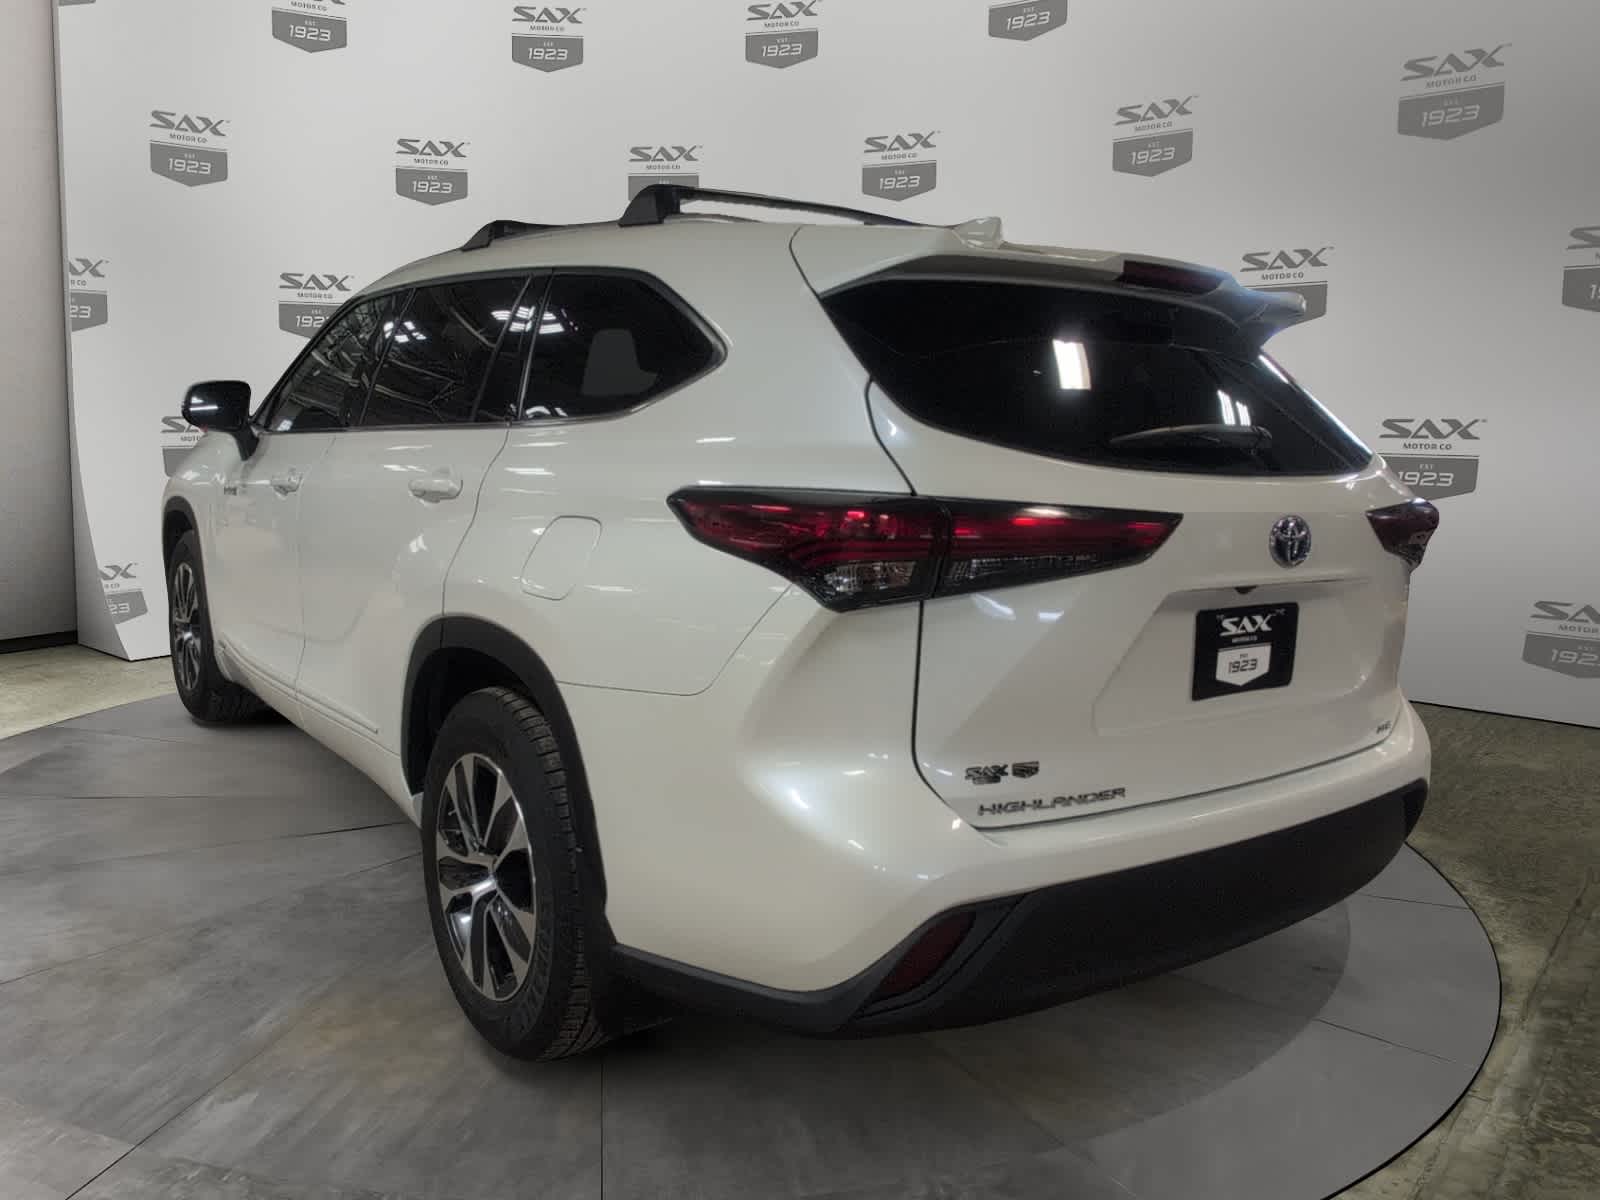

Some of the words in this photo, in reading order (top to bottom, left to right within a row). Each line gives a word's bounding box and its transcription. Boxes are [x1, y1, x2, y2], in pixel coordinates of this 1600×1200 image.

[512, 6, 583, 23] SAX
[746, 0, 818, 21] SAX
[1007, 11, 1050, 30] 1923
[290, 25, 331, 41] 1923
[528, 48, 568, 60] 1923
[762, 43, 802, 56] 1923
[1400, 45, 1504, 82] SAX
[1115, 96, 1192, 126] SAX
[1422, 105, 1480, 128] 1923
[150, 110, 227, 137] SAX
[395, 139, 467, 158] SAX
[864, 131, 936, 153] SAX
[629, 146, 698, 161] SAX
[1131, 147, 1175, 165] 1923
[169, 158, 211, 175] 1923
[412, 181, 453, 193] 1923
[880, 175, 920, 190] 1923
[1240, 248, 1328, 272] SAX
[279, 273, 351, 291] SAX
[1261, 272, 1291, 281] MOTOR
[70, 304, 91, 318] 23
[296, 315, 329, 329] 192
[1379, 419, 1480, 440] SAX
[1402, 442, 1437, 451] MOTOR
[1439, 443, 1453, 452] CO
[1530, 600, 1600, 624] SA
[1220, 614, 1272, 637] SAX
[1228, 658, 1258, 674] 1923
[1552, 649, 1600, 666] 192
[979, 787, 1126, 815] HIGHLANDER
